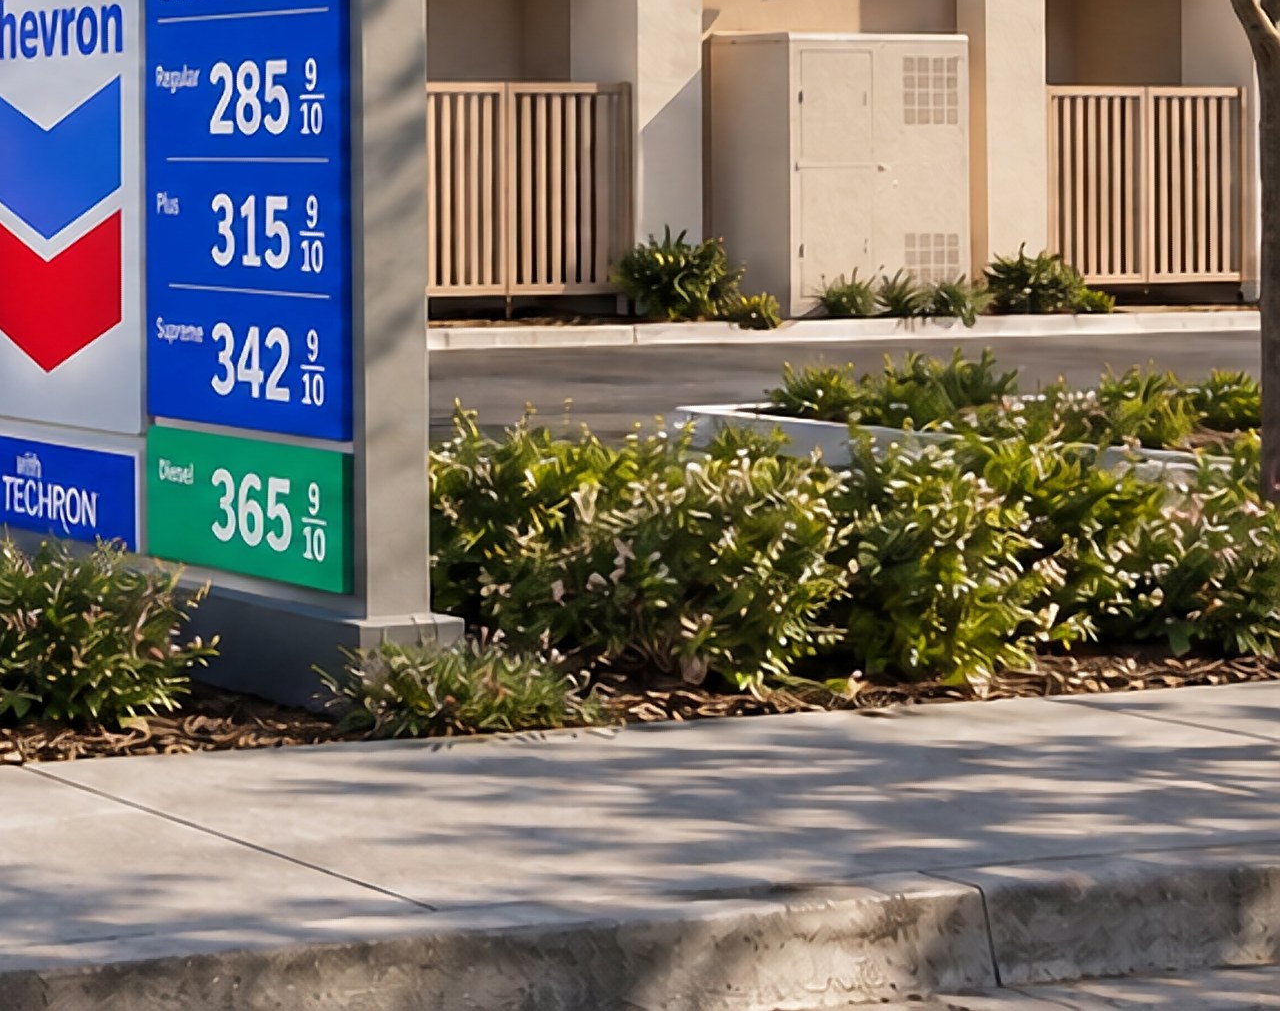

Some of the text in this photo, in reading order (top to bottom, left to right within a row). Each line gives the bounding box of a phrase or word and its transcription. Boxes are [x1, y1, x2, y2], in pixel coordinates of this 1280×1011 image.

[305, 57, 317, 91] 9
[209, 59, 290, 135] 285
[300, 101, 323, 135] 10
[156, 191, 323, 274] Plus 315 9 10
[211, 322, 290, 402] 342
[306, 328, 319, 362] 9
[301, 372, 324, 407] 10
[2, 474, 98, 534] TECHRON
[211, 468, 292, 552] 365
[308, 482, 320, 516] 9
[302, 526, 326, 562] 10
